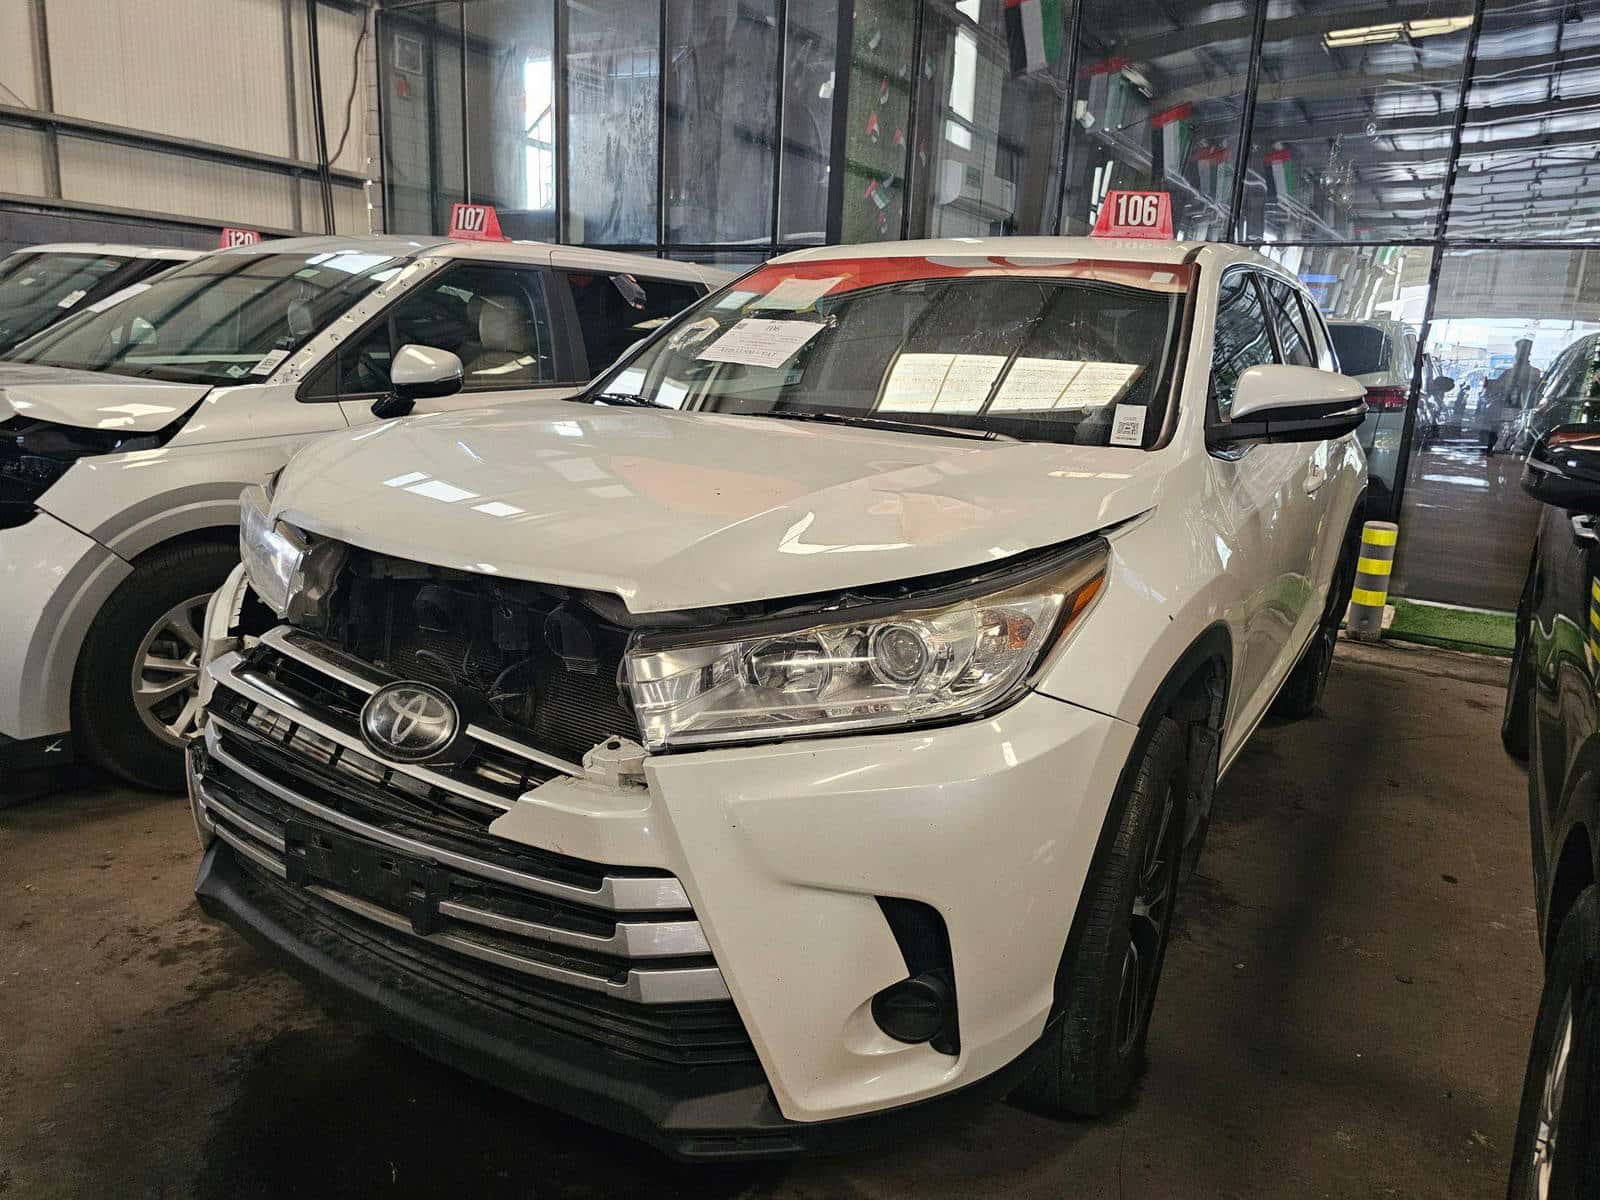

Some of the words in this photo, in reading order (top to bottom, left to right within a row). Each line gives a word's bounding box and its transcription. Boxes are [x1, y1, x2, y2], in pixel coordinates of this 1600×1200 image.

[458, 207, 484, 231] 107
[1118, 195, 1158, 226] 106
[230, 231, 253, 248] 120
